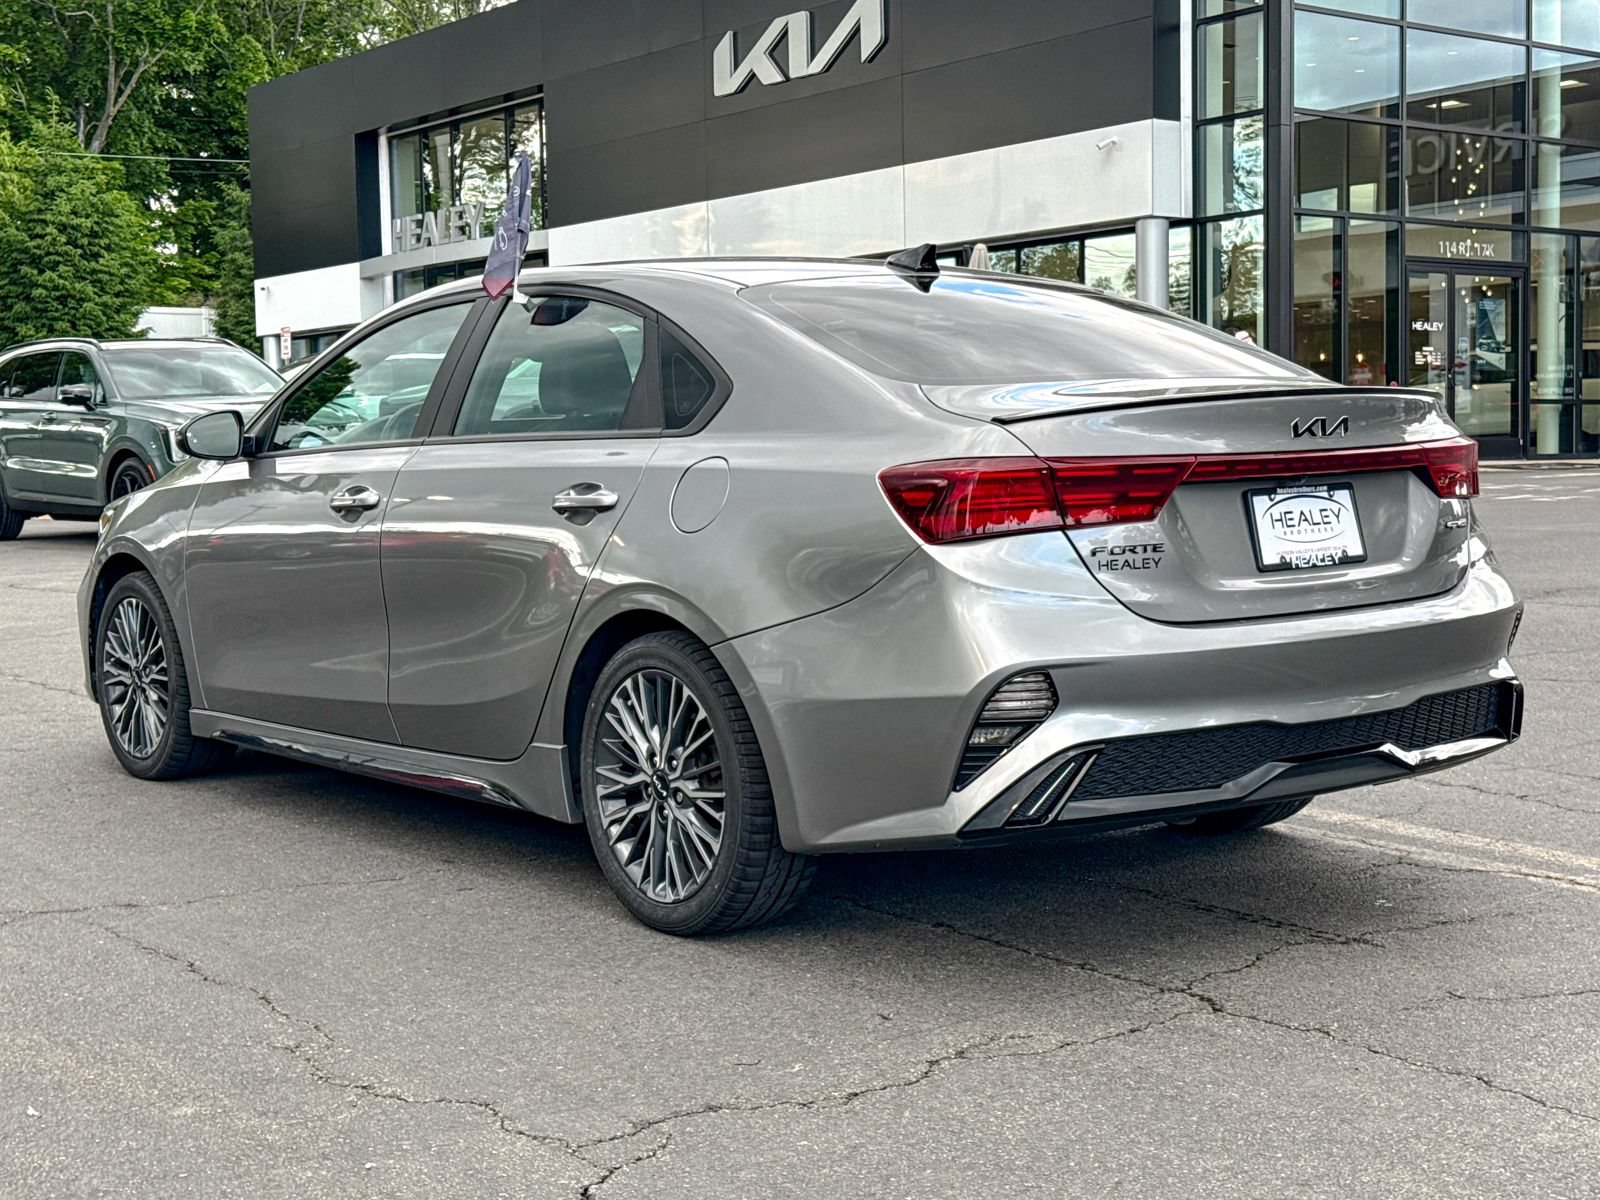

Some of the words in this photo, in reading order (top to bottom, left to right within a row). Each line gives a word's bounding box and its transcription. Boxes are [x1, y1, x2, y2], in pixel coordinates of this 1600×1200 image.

[713, 0, 886, 97] KIA
[392, 202, 485, 254] HEALEY
[1438, 240, 1457, 258] 114
[1411, 321, 1444, 331] HEALEY
[1291, 415, 1349, 438] KIA
[1270, 507, 1341, 529] HEALEY
[1283, 526, 1334, 536] BROTHERS
[1090, 542, 1165, 557] FORTE
[1098, 557, 1162, 571] HEALEY
[1290, 552, 1339, 569] HEALEY
